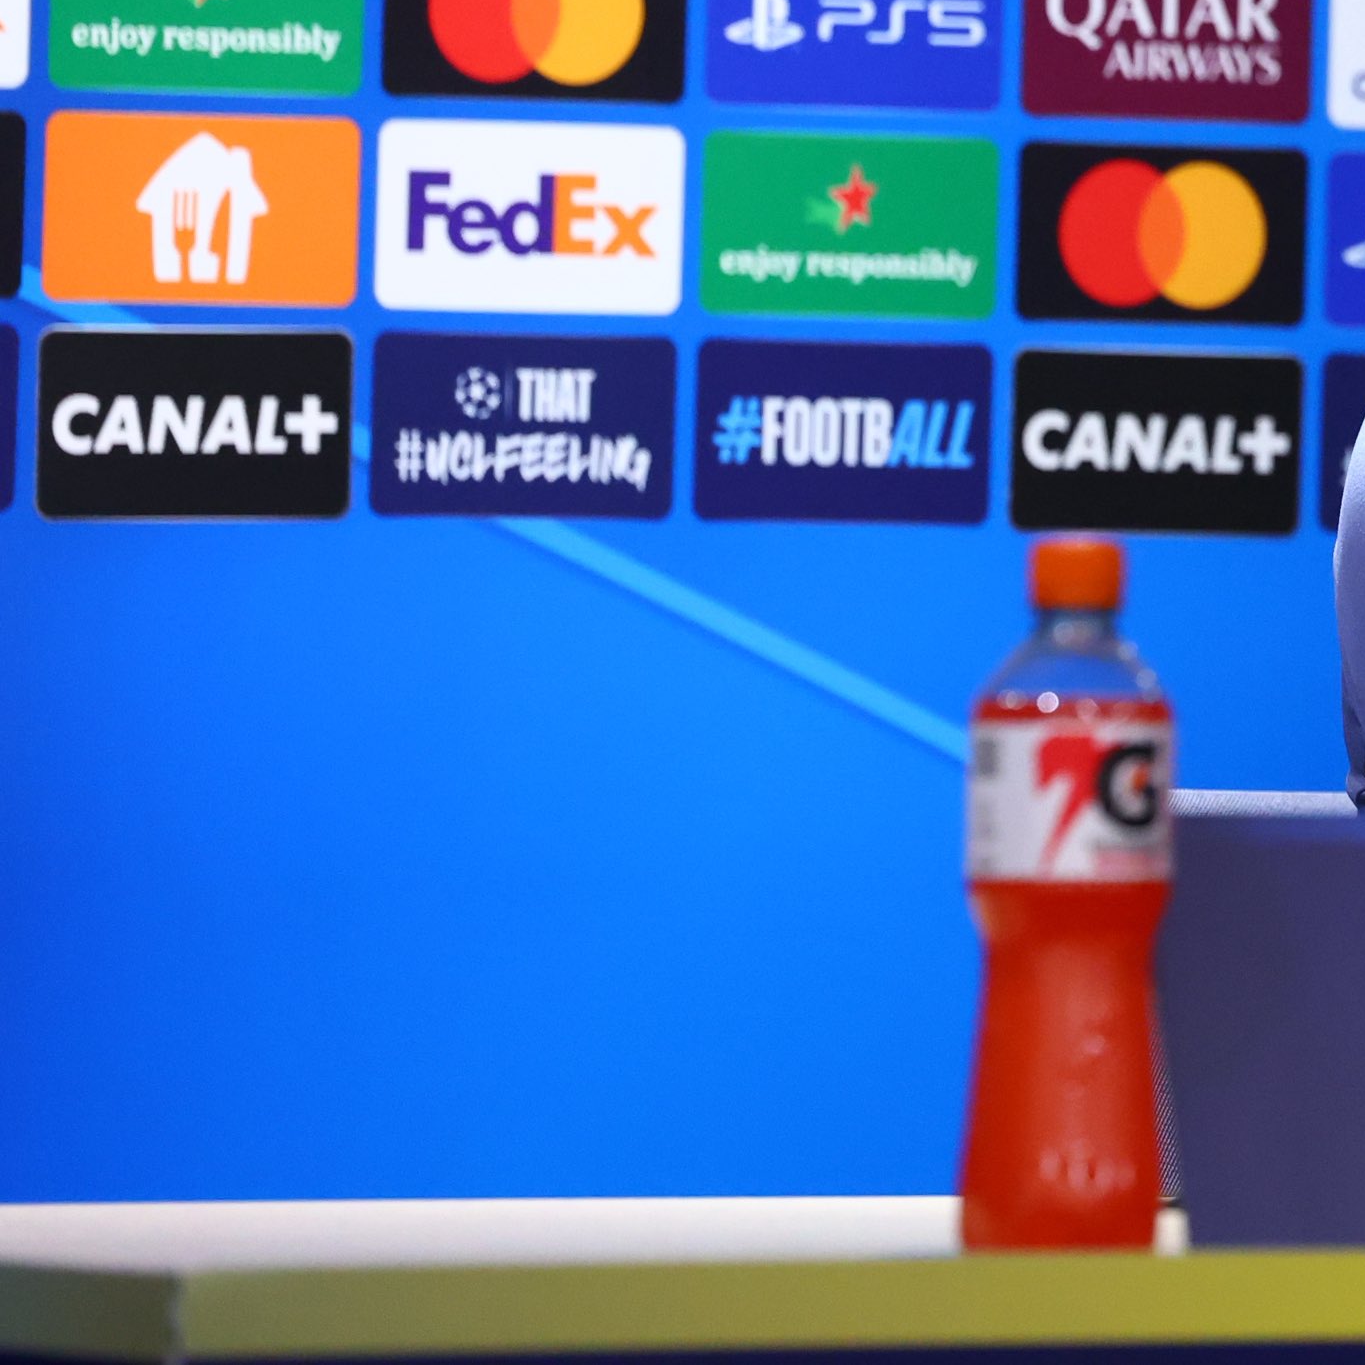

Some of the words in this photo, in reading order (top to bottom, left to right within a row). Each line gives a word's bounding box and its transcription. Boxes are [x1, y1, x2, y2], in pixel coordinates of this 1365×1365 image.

[72, 16, 157, 55] enjoy
[164, 20, 341, 61] responsibly
[1104, 42, 1282, 85] AIRWAYS
[406, 170, 656, 259] FedEx
[720, 244, 800, 283] enjoy
[807, 248, 978, 287] responsibly
[517, 368, 596, 422] THAT
[52, 393, 338, 456] CANAL+
[714, 396, 975, 468] #FOOTBALL
[1022, 407, 1292, 476] CANAL+
